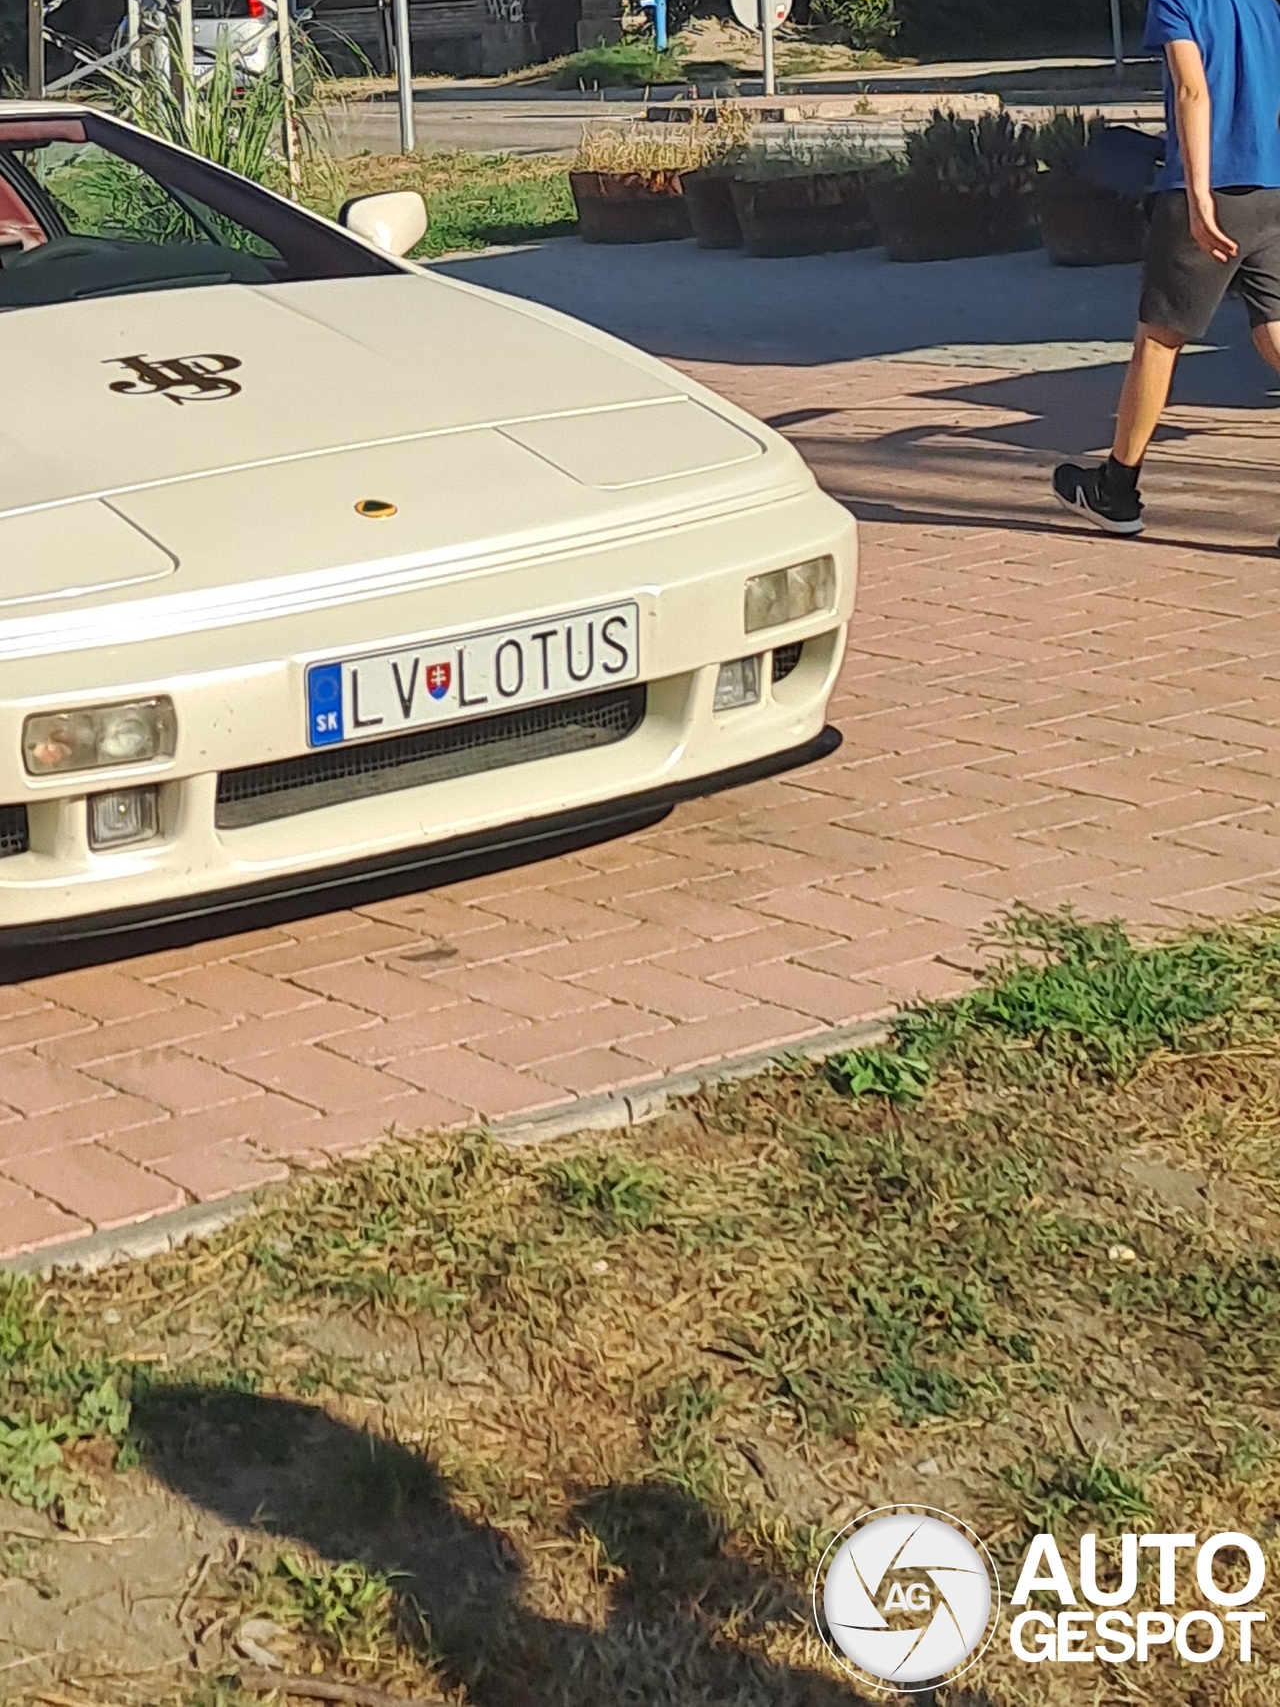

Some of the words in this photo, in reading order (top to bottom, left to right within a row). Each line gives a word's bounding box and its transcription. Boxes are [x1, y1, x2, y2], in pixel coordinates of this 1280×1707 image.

[351, 657, 420, 728] LV
[457, 615, 629, 708] LOTUS
[316, 711, 338, 732] SK
